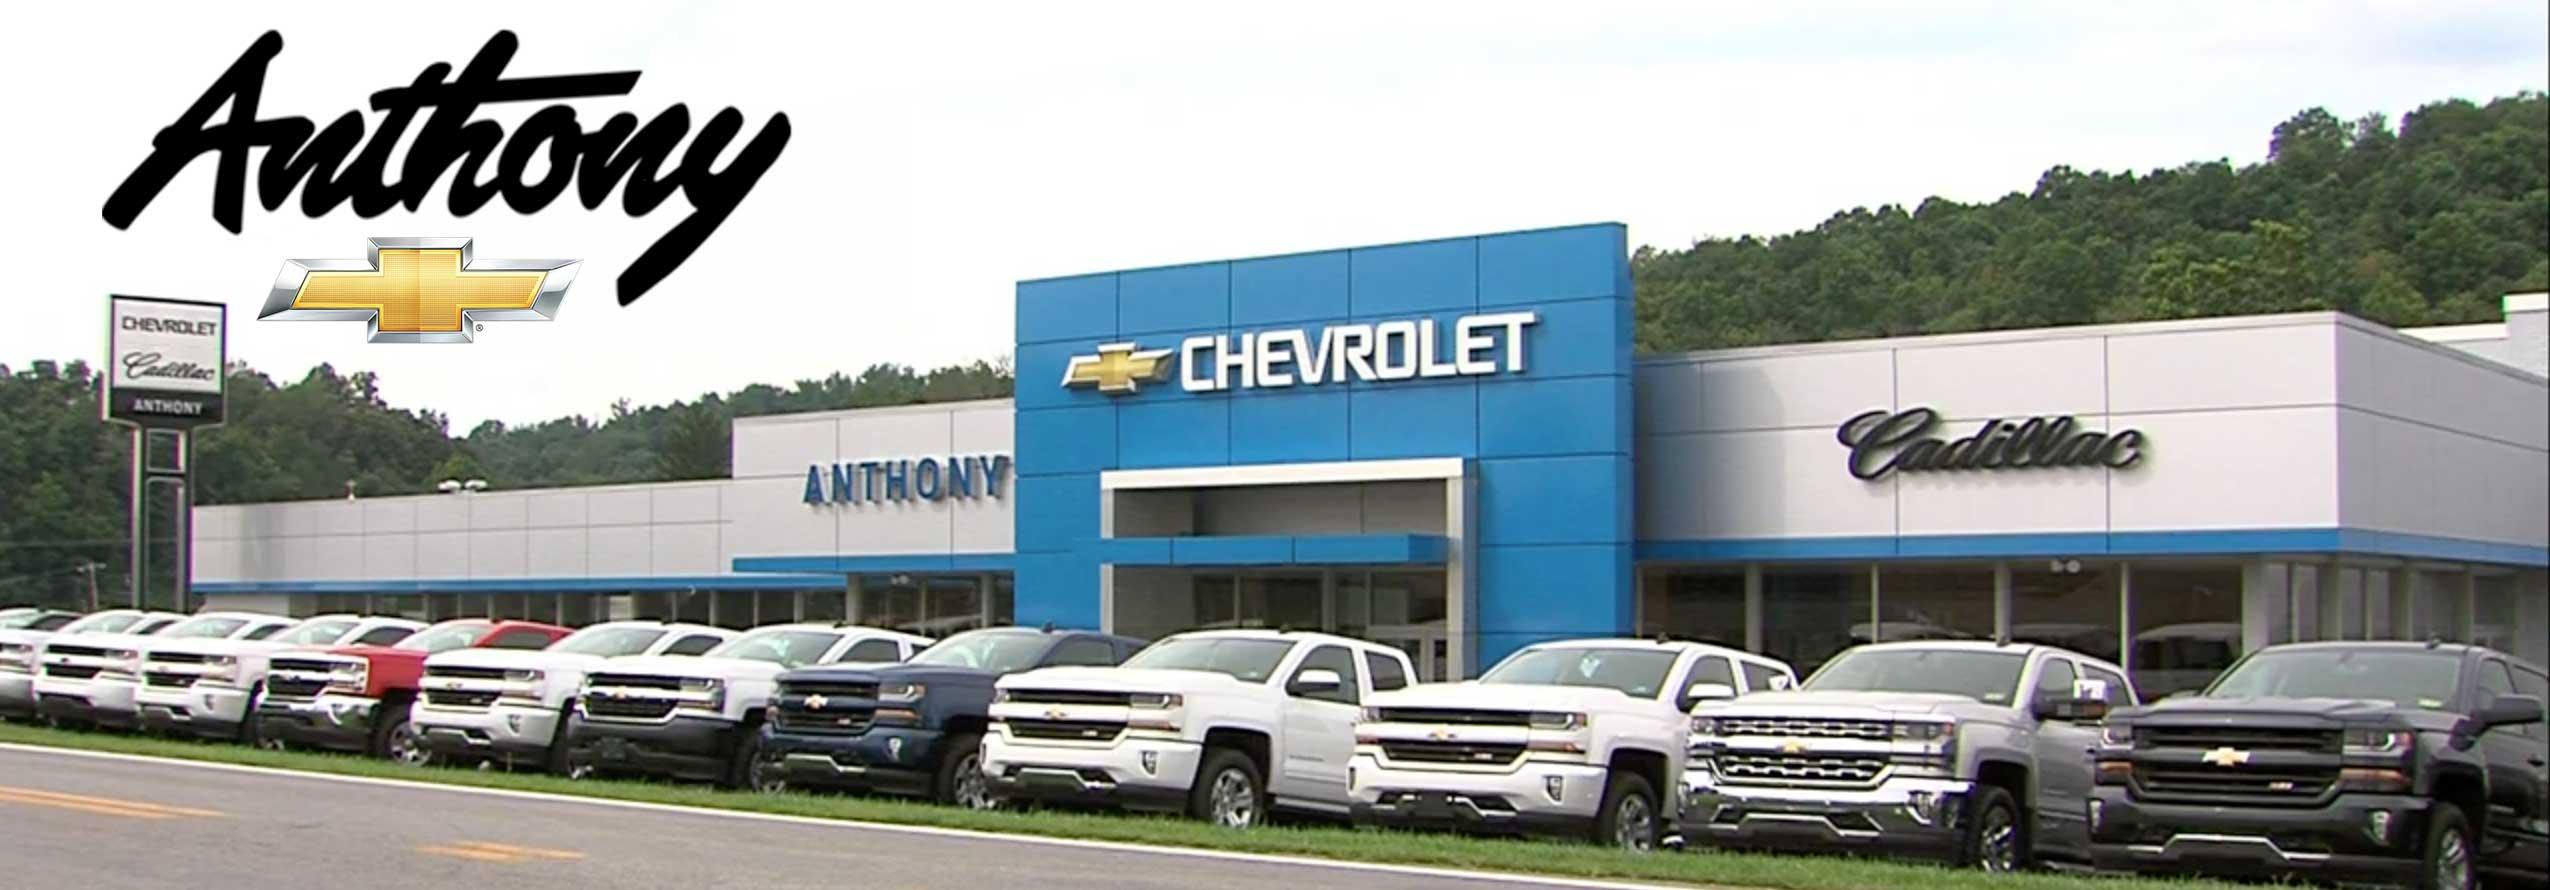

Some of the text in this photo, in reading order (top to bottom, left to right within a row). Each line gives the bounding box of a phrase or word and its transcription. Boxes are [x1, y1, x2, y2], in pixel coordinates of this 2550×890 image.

[122, 316, 217, 336] CHEVROLET
[123, 352, 216, 381] Cadillac
[1180, 311, 1537, 392] CHEVROLET
[133, 398, 203, 415] ANTHONY
[1837, 407, 2144, 481] Cadillac
[802, 455, 1010, 504] ANTHONY
